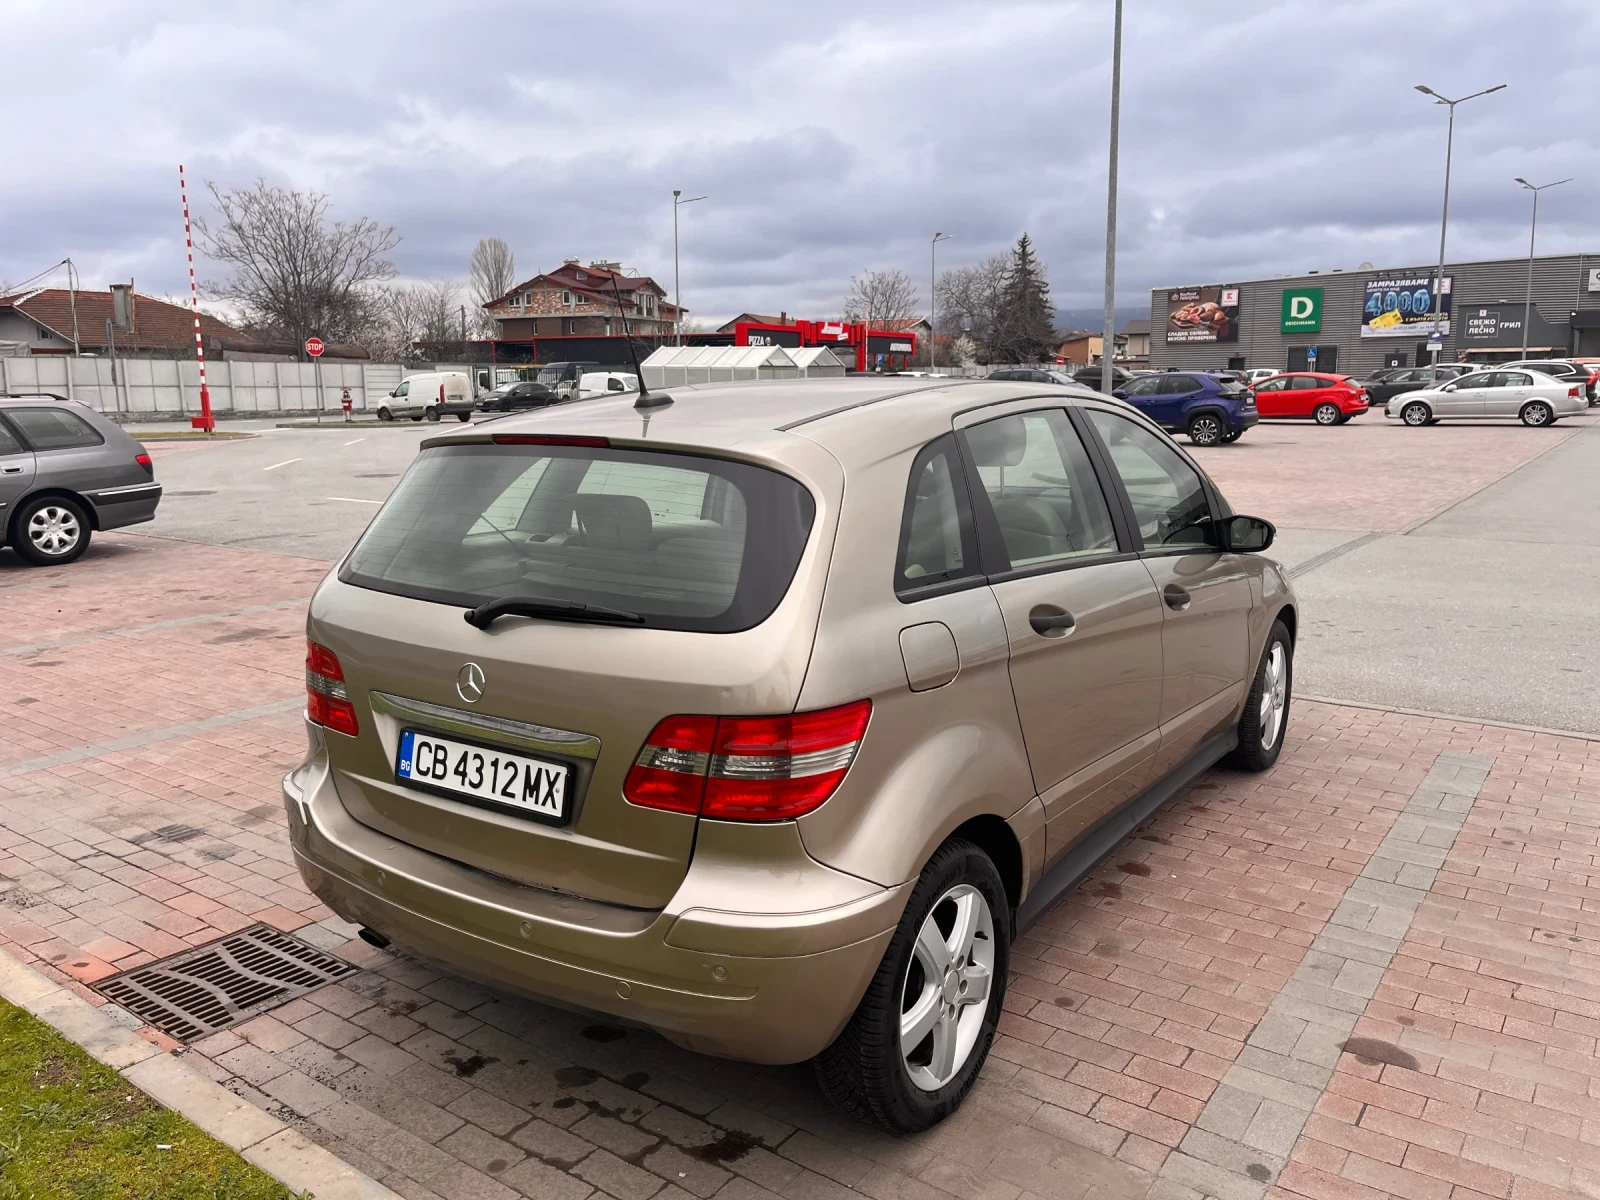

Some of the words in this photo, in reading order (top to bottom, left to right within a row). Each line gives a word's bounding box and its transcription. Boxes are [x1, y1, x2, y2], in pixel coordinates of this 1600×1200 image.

[1367, 278, 1430, 288] ЗАМРАЗЯВАМЕ
[1365, 288, 1431, 316] 4000
[1291, 296, 1314, 319] D
[1469, 318, 1496, 326] СВЕЖО
[1500, 321, 1521, 329] ГРИЛ
[1468, 327, 1495, 335] ЛЕСНО
[748, 335, 765, 346] PIZZA
[307, 343, 323, 351] STOP
[400, 759, 411, 772] BG
